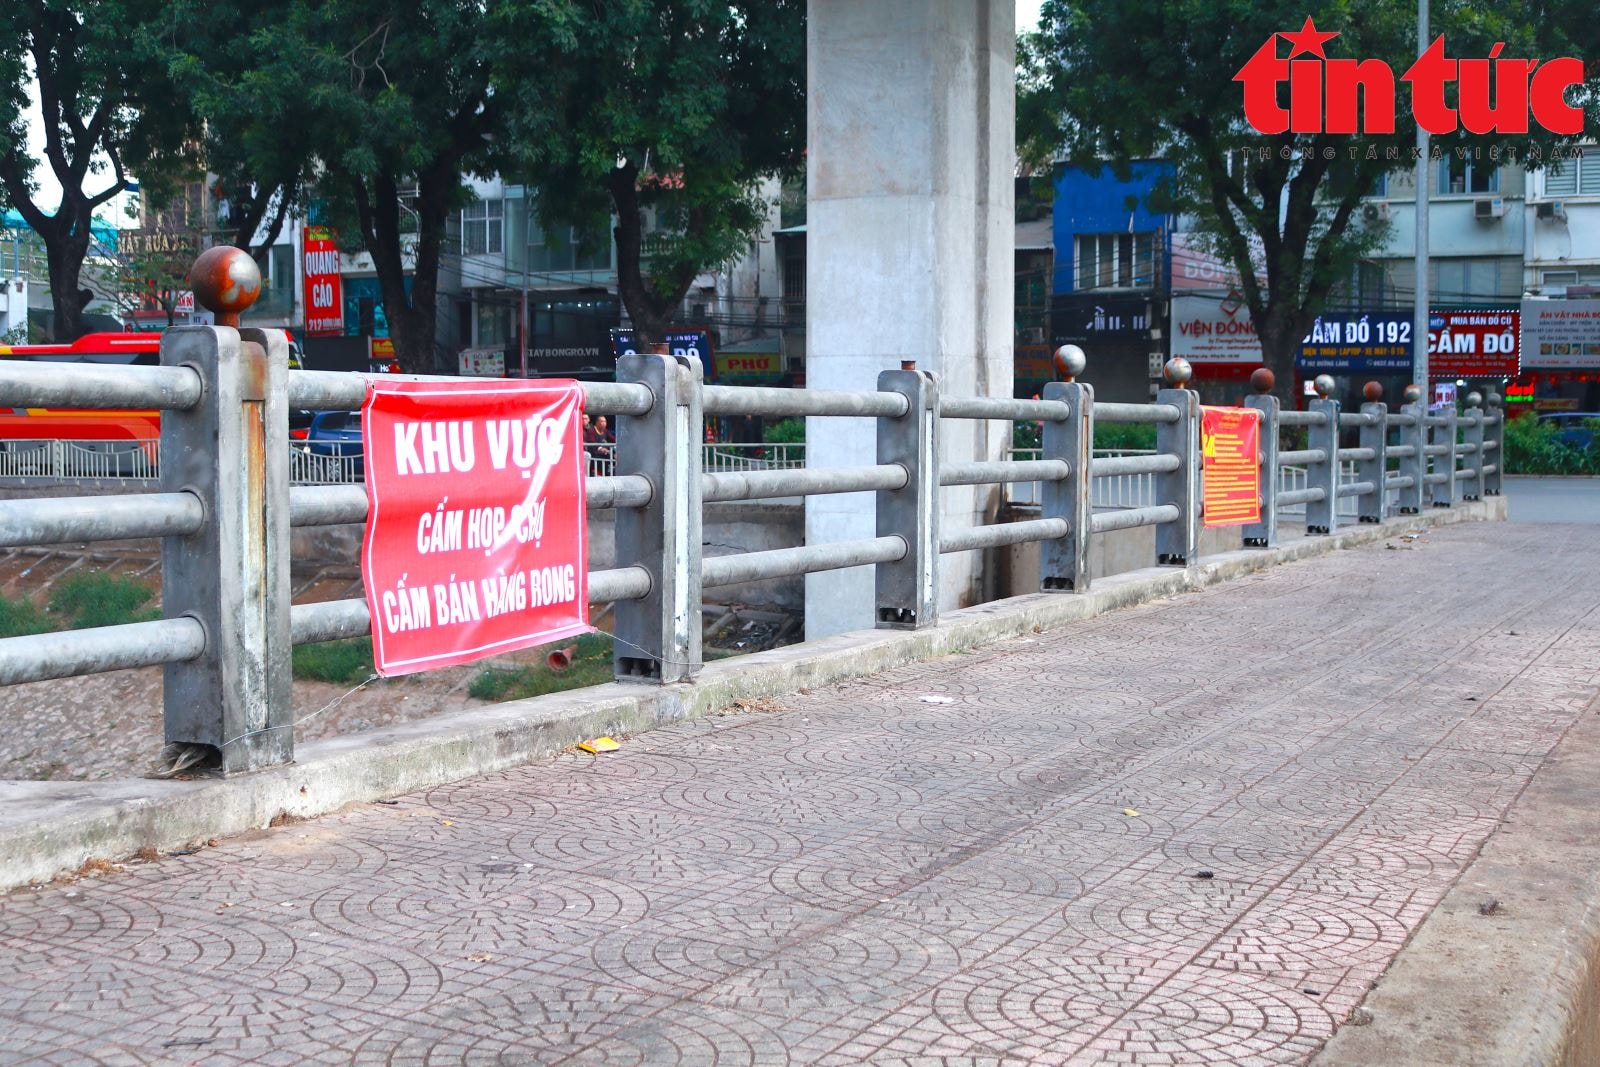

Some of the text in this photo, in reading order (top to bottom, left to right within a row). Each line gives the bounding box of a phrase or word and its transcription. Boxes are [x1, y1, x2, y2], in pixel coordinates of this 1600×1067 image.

[305, 241, 339, 278] QUẢNG
[312, 278, 333, 308] CÁO
[1179, 319, 1213, 338] VIỆN
[1376, 321, 1411, 344] 192
[393, 414, 564, 479] KHU VỰC
[417, 496, 463, 554] CẤM
[383, 563, 575, 634] CẤM BÁN HÀNG RONG
